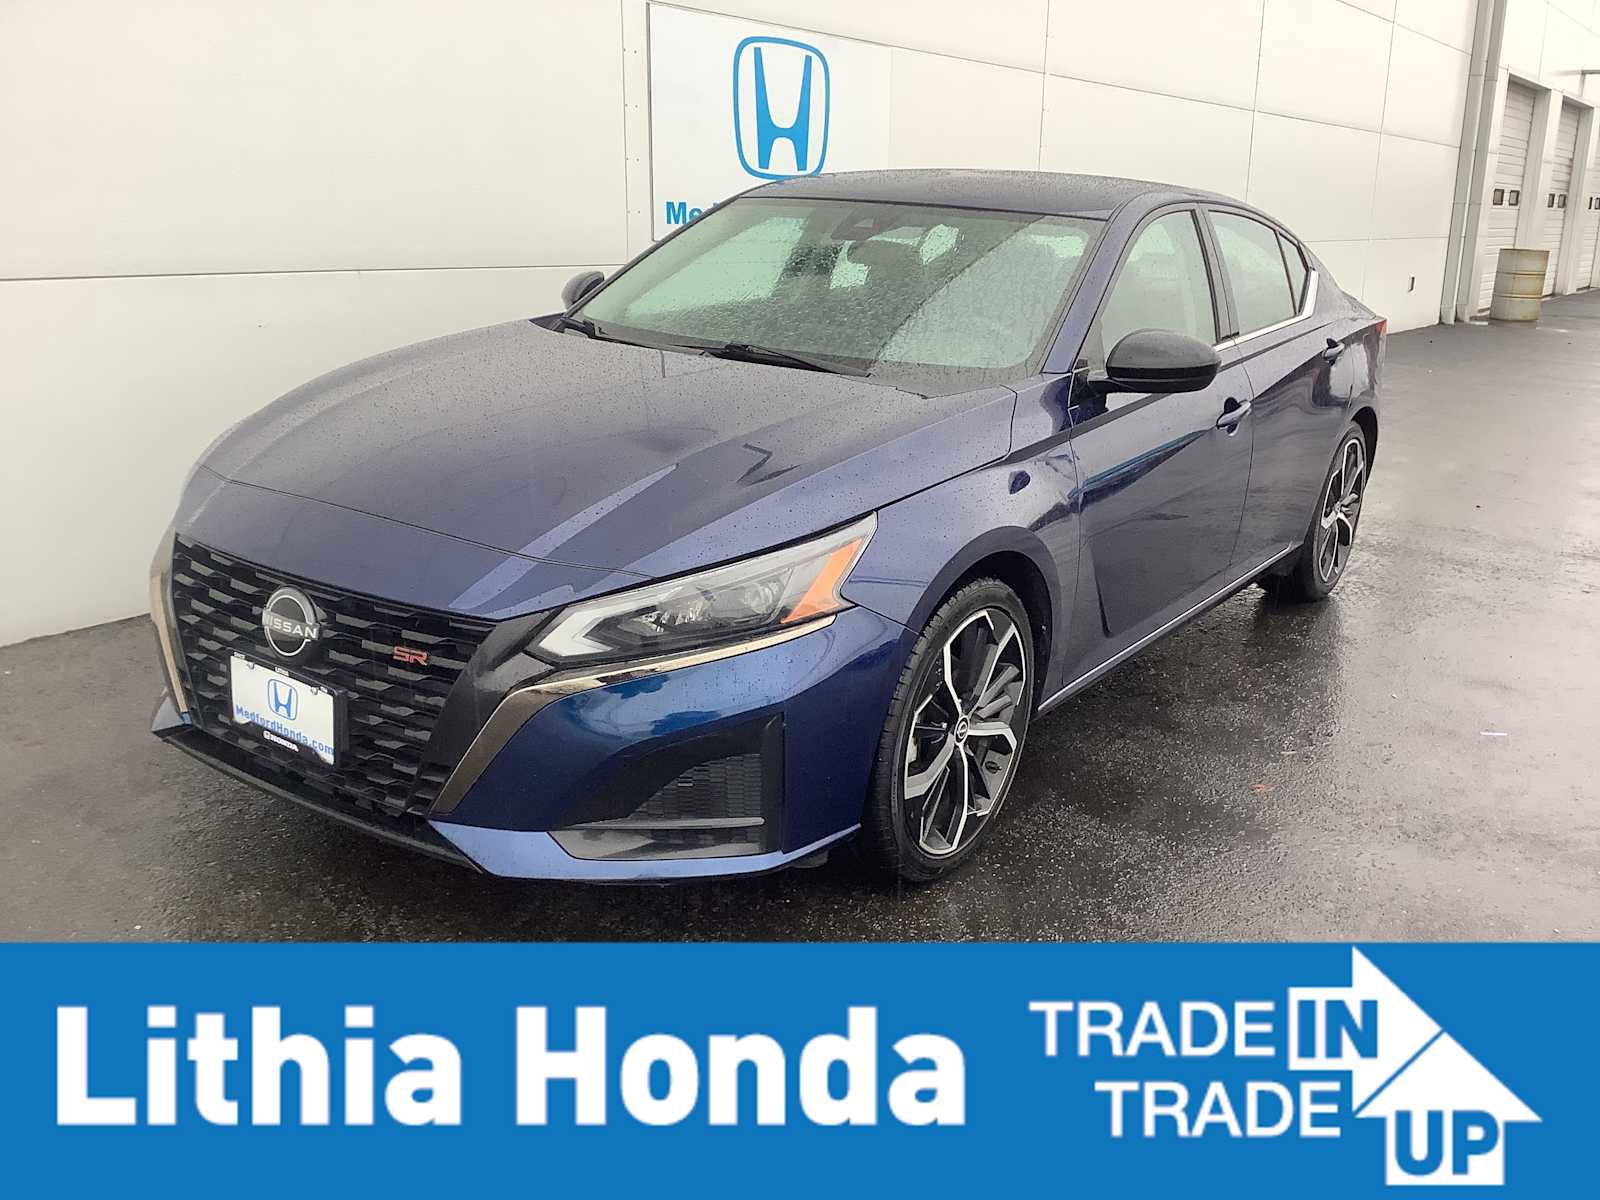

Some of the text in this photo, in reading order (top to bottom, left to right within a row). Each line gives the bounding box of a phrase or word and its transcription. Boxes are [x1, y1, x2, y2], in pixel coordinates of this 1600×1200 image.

[262, 611, 317, 639] NISSAN
[392, 645, 430, 667] SR
[235, 704, 334, 756] MedfordHonda.com
